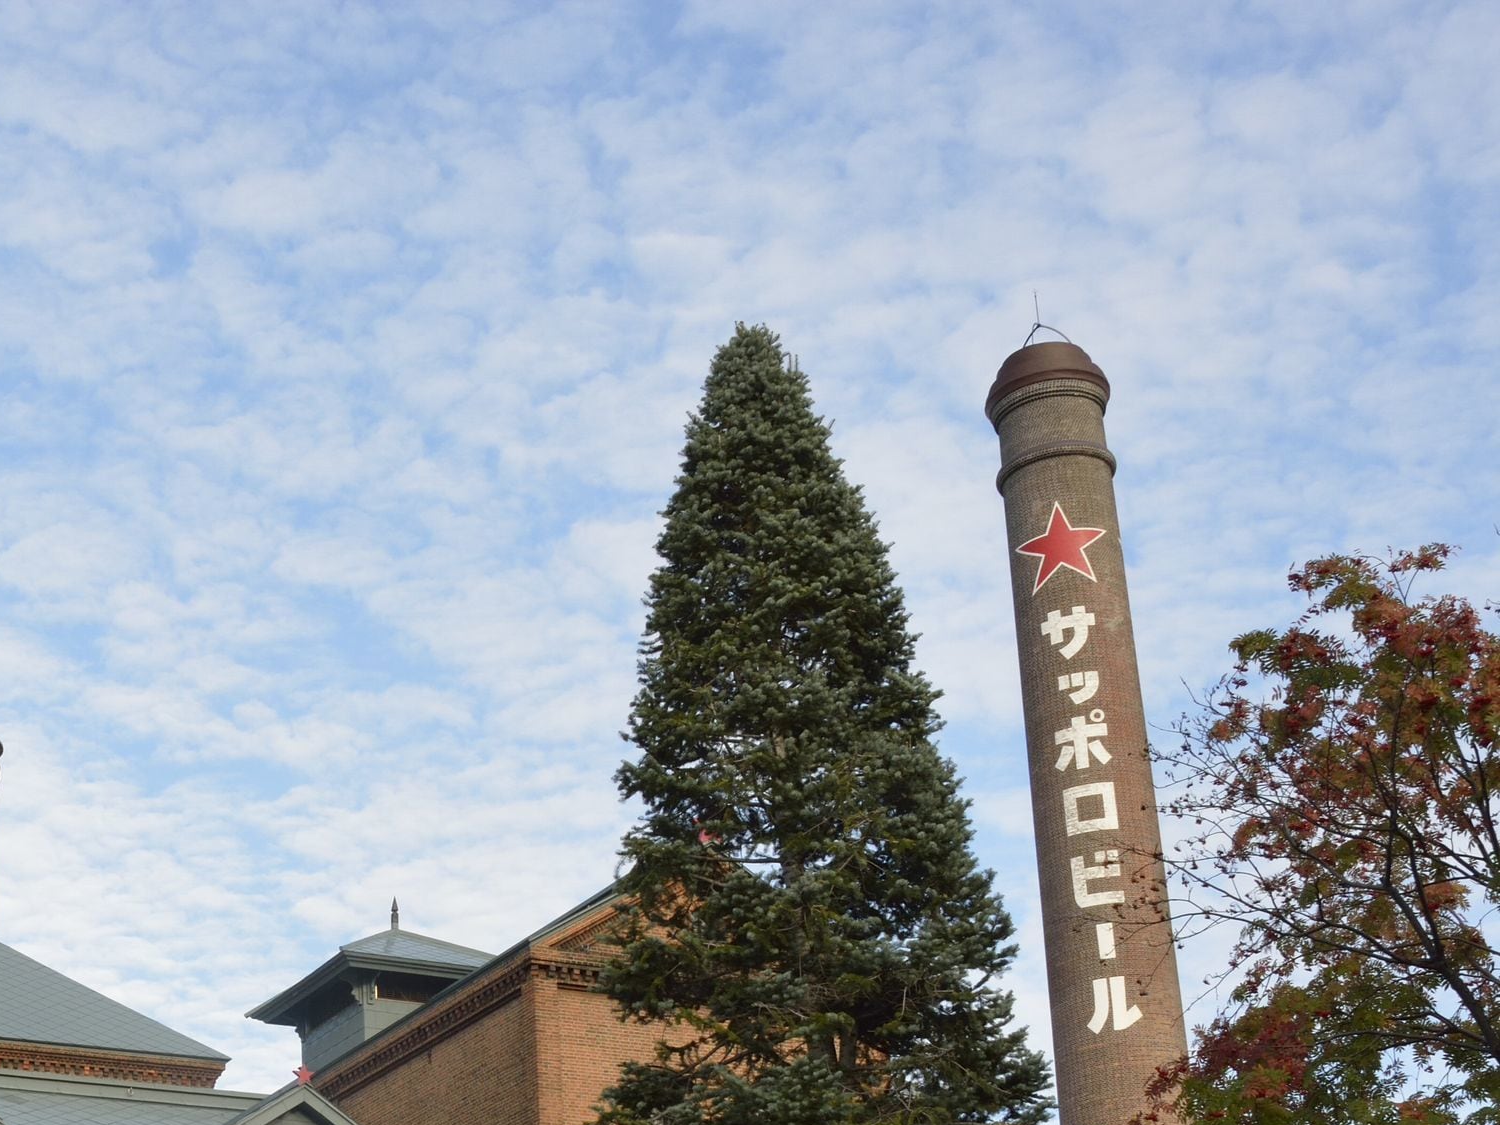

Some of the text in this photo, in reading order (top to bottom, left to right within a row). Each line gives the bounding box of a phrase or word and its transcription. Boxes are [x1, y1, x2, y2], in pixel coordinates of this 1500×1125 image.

[1041, 605, 1143, 1035] サッポロビール
